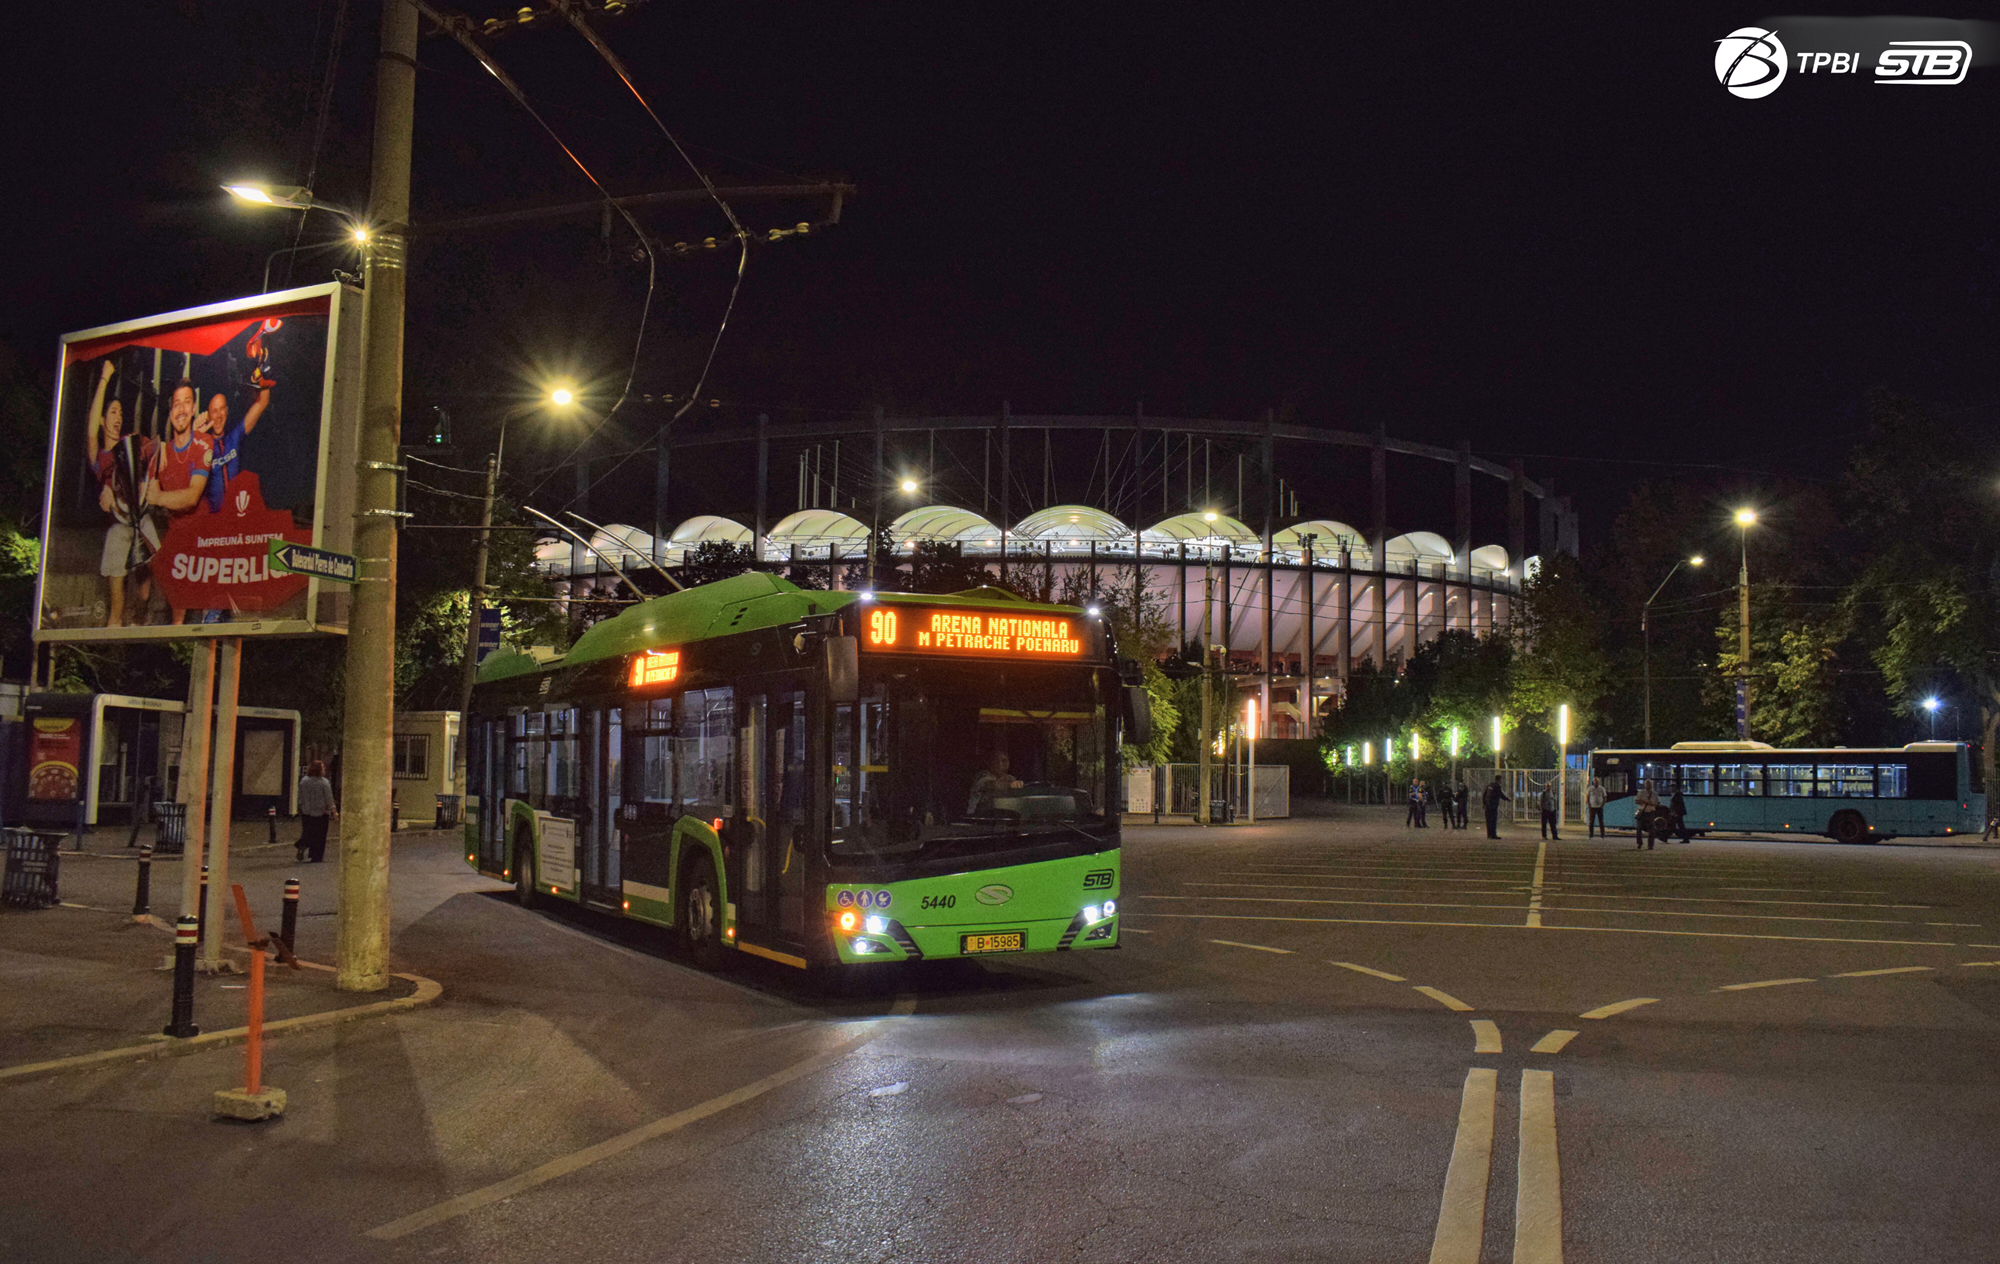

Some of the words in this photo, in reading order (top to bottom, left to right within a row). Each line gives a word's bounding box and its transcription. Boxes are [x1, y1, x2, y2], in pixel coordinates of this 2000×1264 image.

[211, 448, 237, 469] FCSB
[197, 533, 243, 548] ÎMPREUNĂ
[171, 552, 294, 584] SUPERLI
[870, 611, 897, 645] 90
[931, 614, 981, 634] ARENA
[988, 617, 1068, 639] NATIONALA
[918, 632, 930, 646] M
[936, 633, 1011, 650] PETRACHE
[1016, 637, 1079, 653] POENARU
[1083, 872, 1113, 888] STB
[920, 894, 956, 910] 5440
